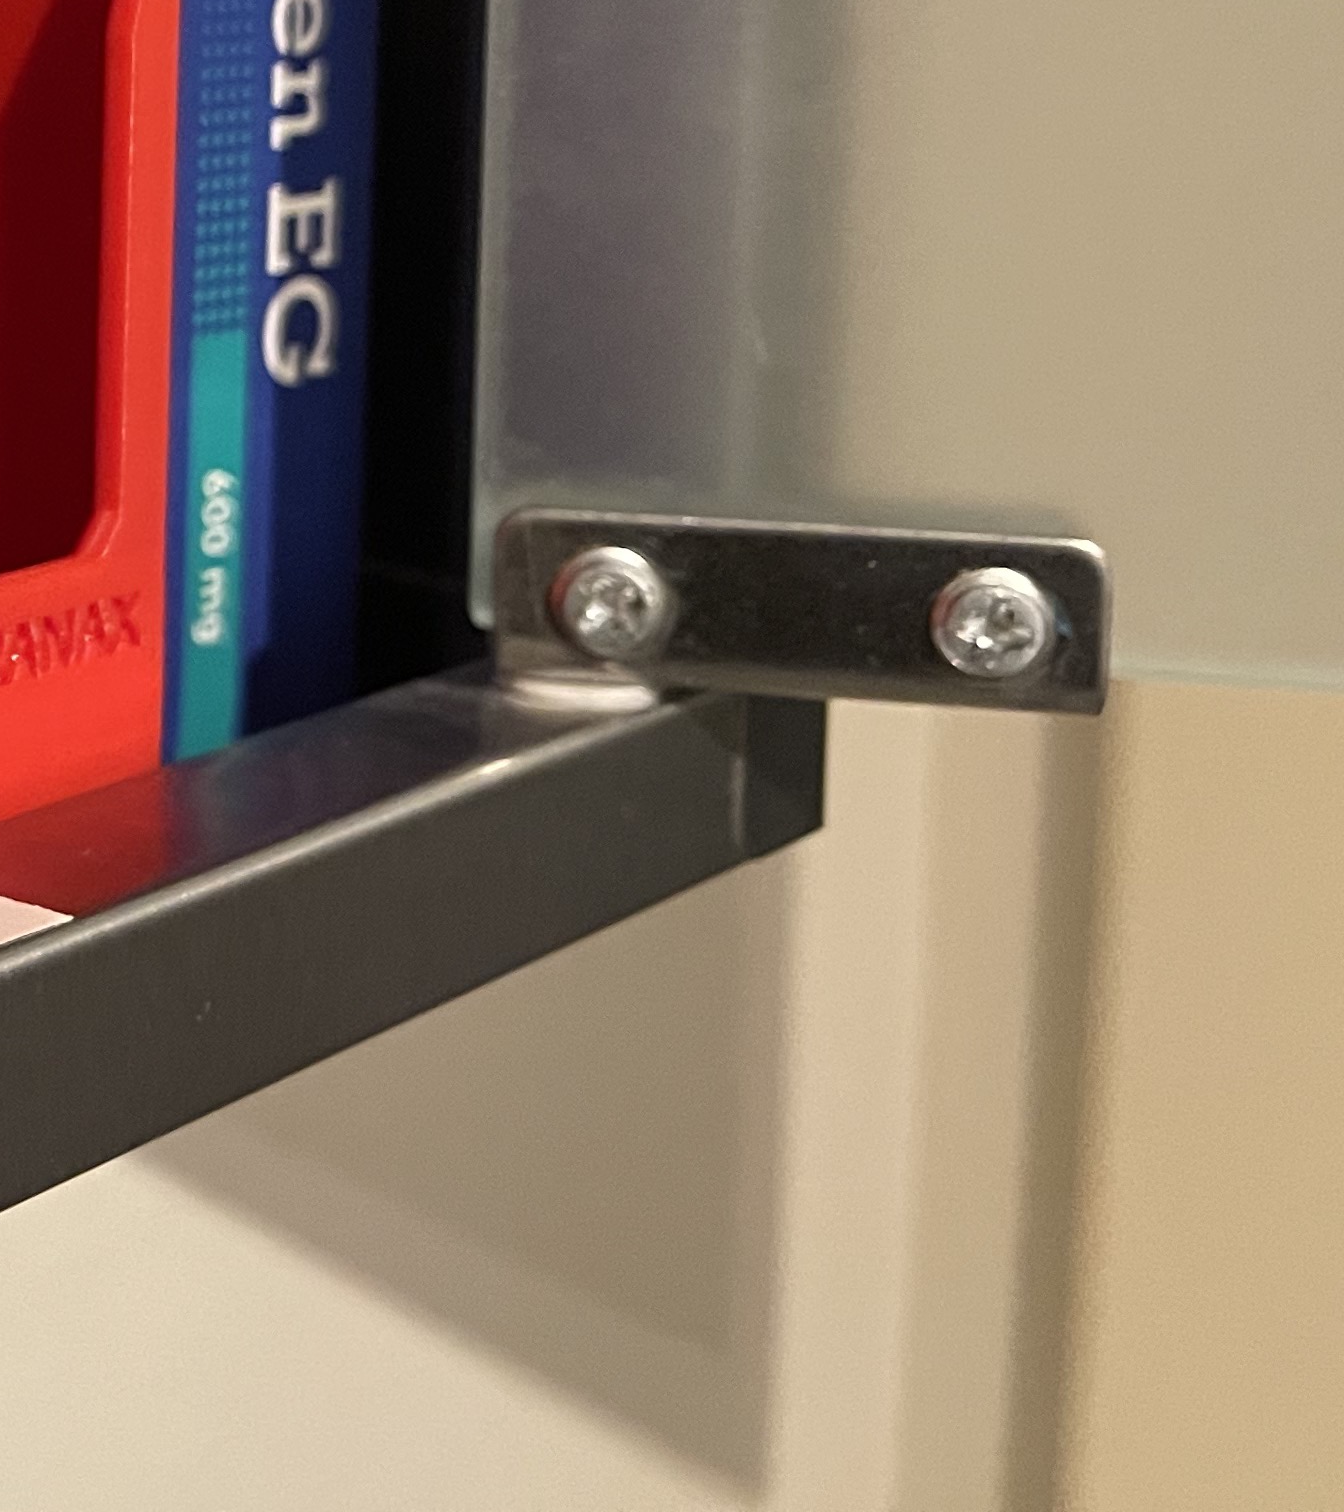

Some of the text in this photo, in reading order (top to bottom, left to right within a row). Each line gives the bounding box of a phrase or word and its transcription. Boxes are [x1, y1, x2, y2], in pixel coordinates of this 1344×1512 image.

[262, 178, 342, 386] EG
[190, 466, 236, 644] 600 mg
